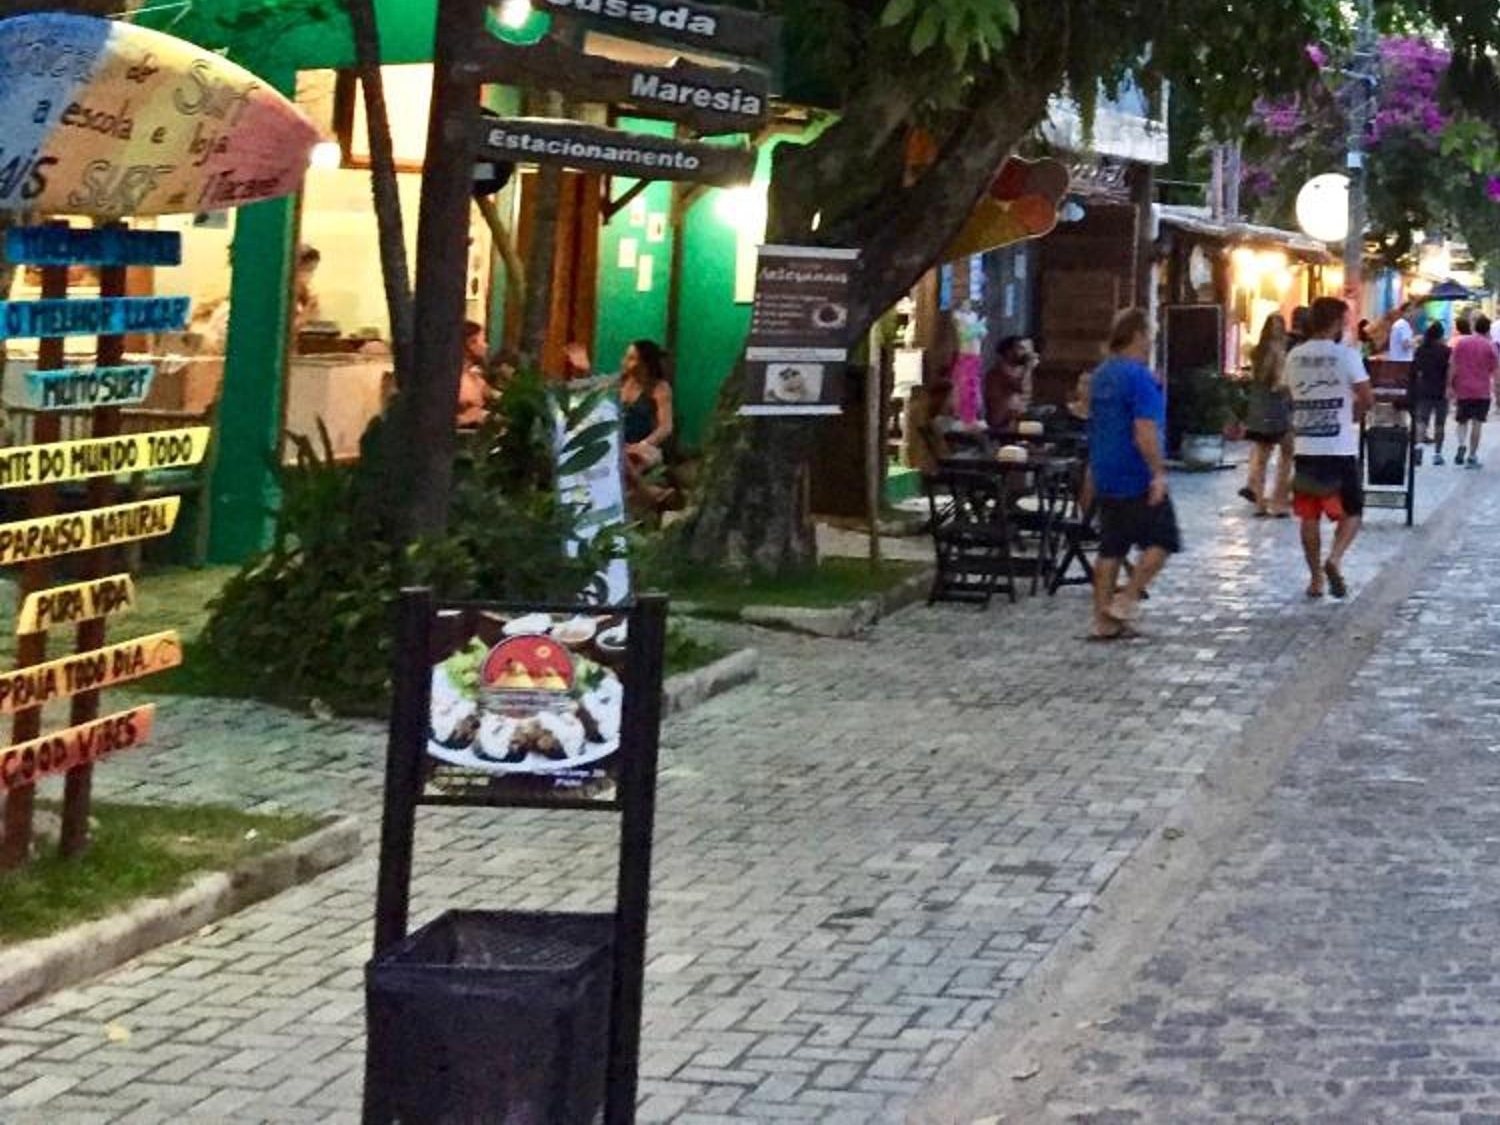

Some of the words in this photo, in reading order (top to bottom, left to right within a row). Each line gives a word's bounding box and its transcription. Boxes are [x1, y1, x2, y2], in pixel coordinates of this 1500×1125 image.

[631, 72, 763, 117] Maresia
[61, 101, 134, 141] escola
[487, 129, 701, 172] Estacionamento
[38, 448, 65, 481] DO
[70, 438, 138, 476] MUNDO
[147, 434, 193, 466] TODO
[91, 503, 168, 546] NATURAL
[36, 588, 84, 630] PURA
